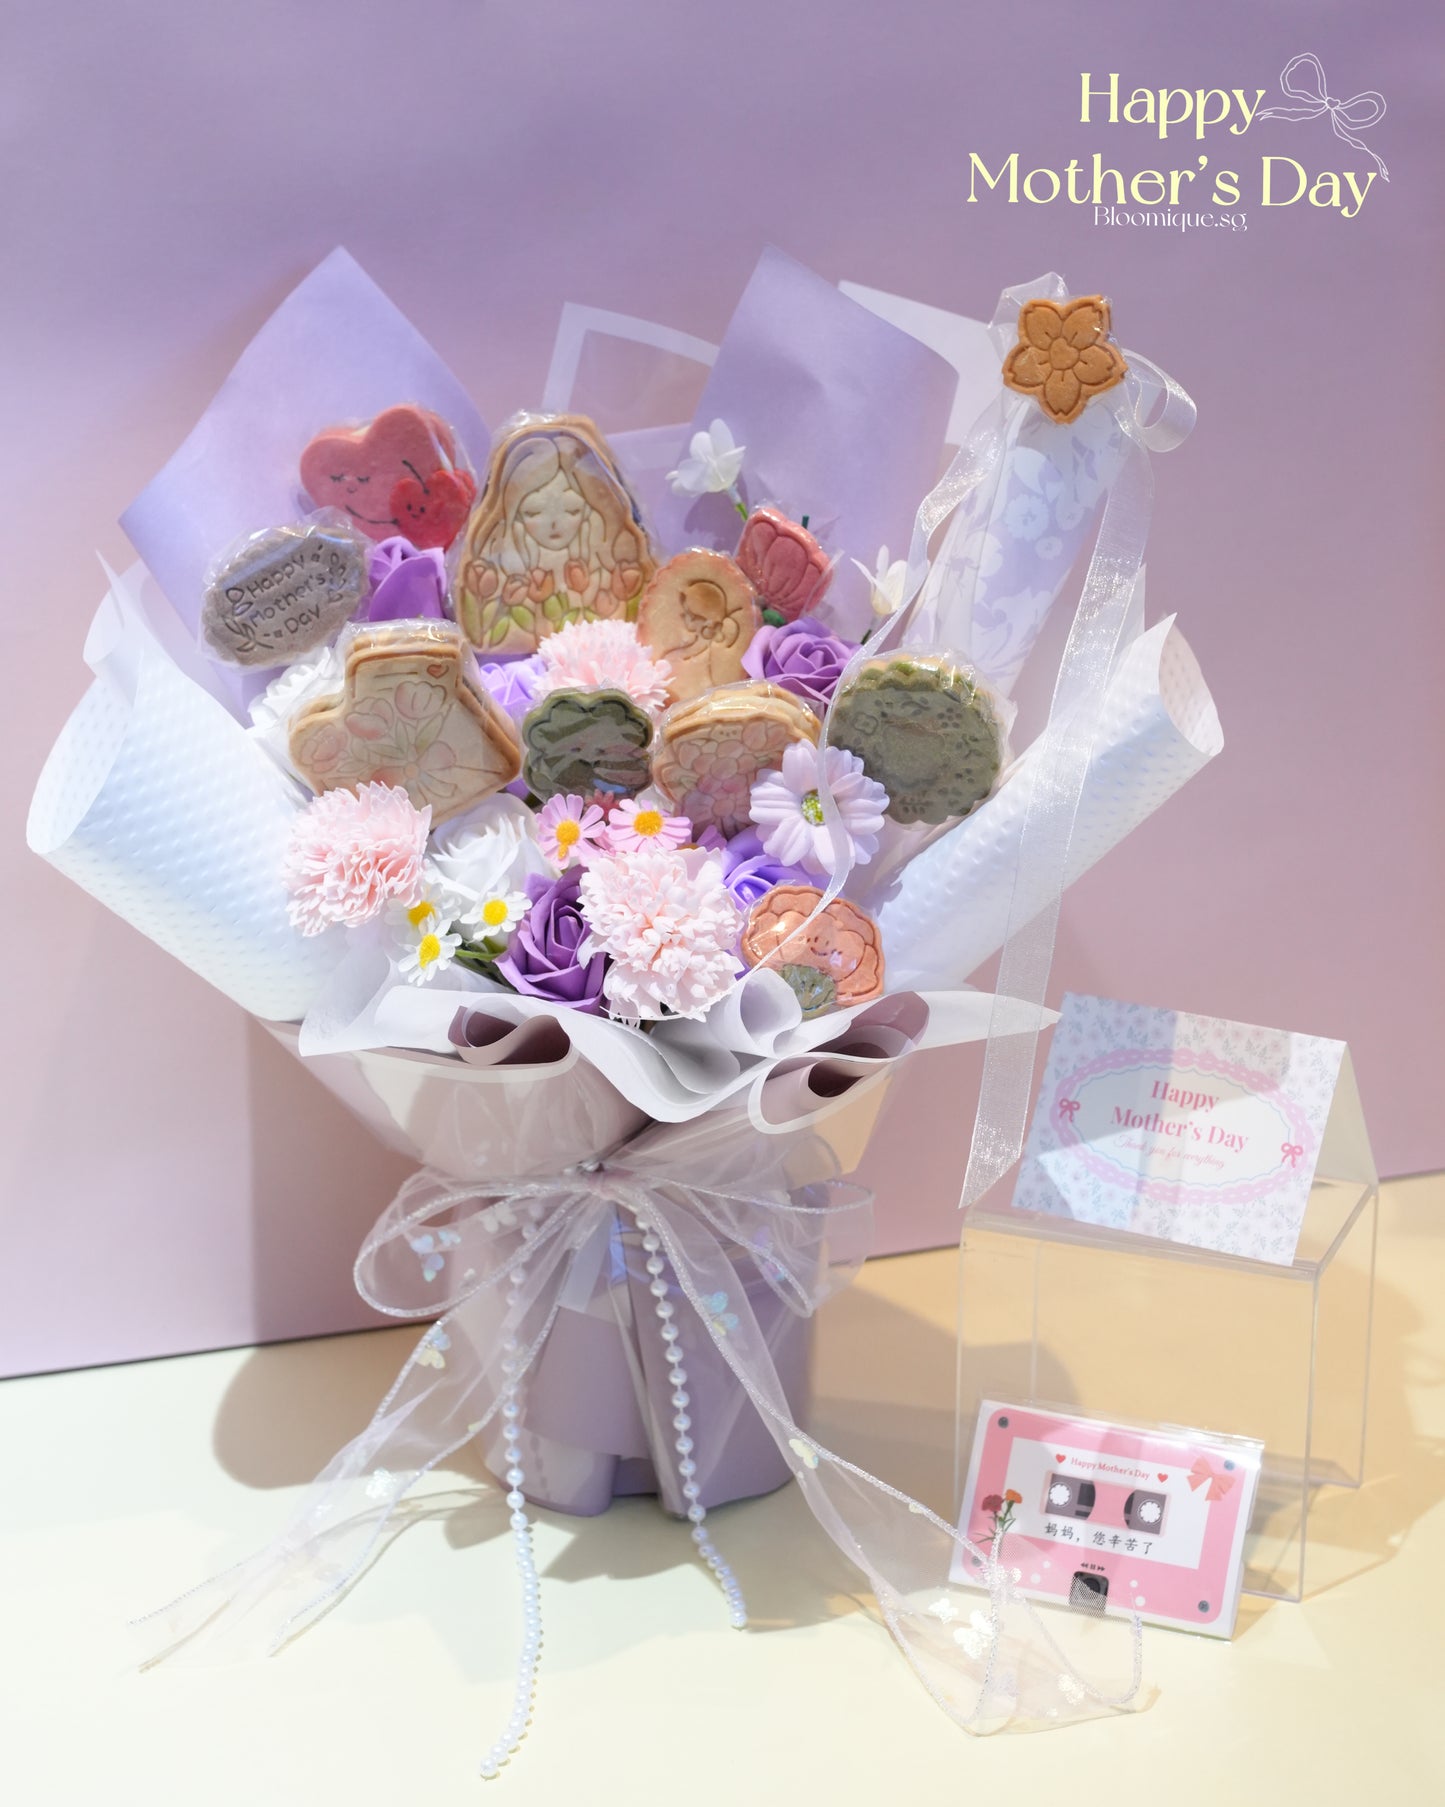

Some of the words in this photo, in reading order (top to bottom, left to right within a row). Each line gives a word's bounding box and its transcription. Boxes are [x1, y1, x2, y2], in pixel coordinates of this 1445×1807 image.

[247, 554, 304, 598] Happy
[249, 573, 326, 627] Mother's
[284, 604, 320, 634] Day
[1151, 1080, 1220, 1113] Happy
[1110, 1106, 1202, 1141] Mother’s
[1208, 1126, 1249, 1153] Day
[1071, 1457, 1097, 1471] Happy
[1134, 1469, 1150, 1480] Day
[1045, 1522, 1153, 1555] 妈妈，您辛苦了
